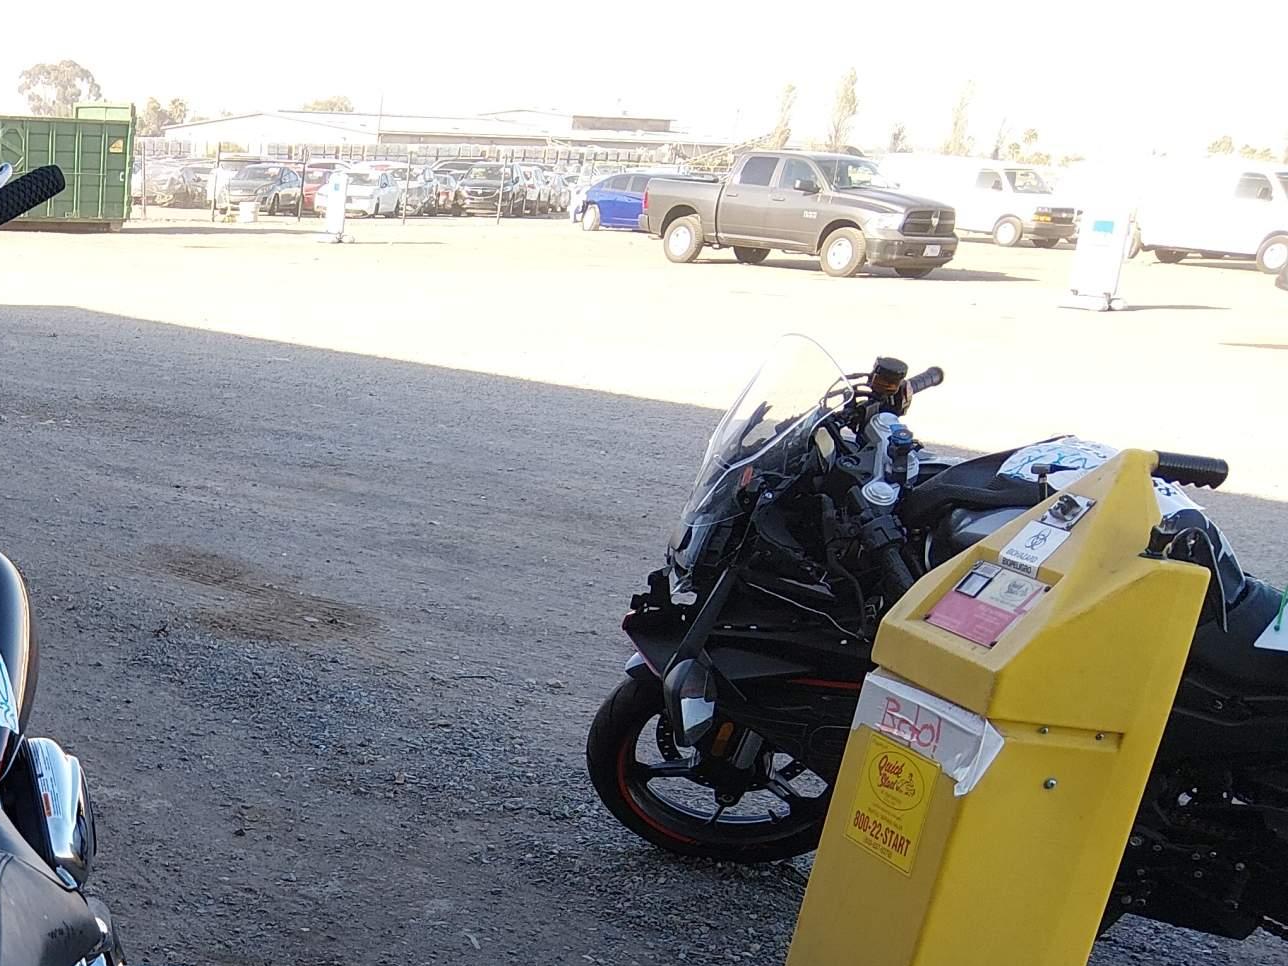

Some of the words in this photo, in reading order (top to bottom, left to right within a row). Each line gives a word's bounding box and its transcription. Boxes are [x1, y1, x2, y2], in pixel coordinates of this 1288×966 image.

[1005, 549, 1038, 564] BIOHAZARD
[878, 755, 906, 779] Quick
[854, 810, 911, 857] 800-22-START
